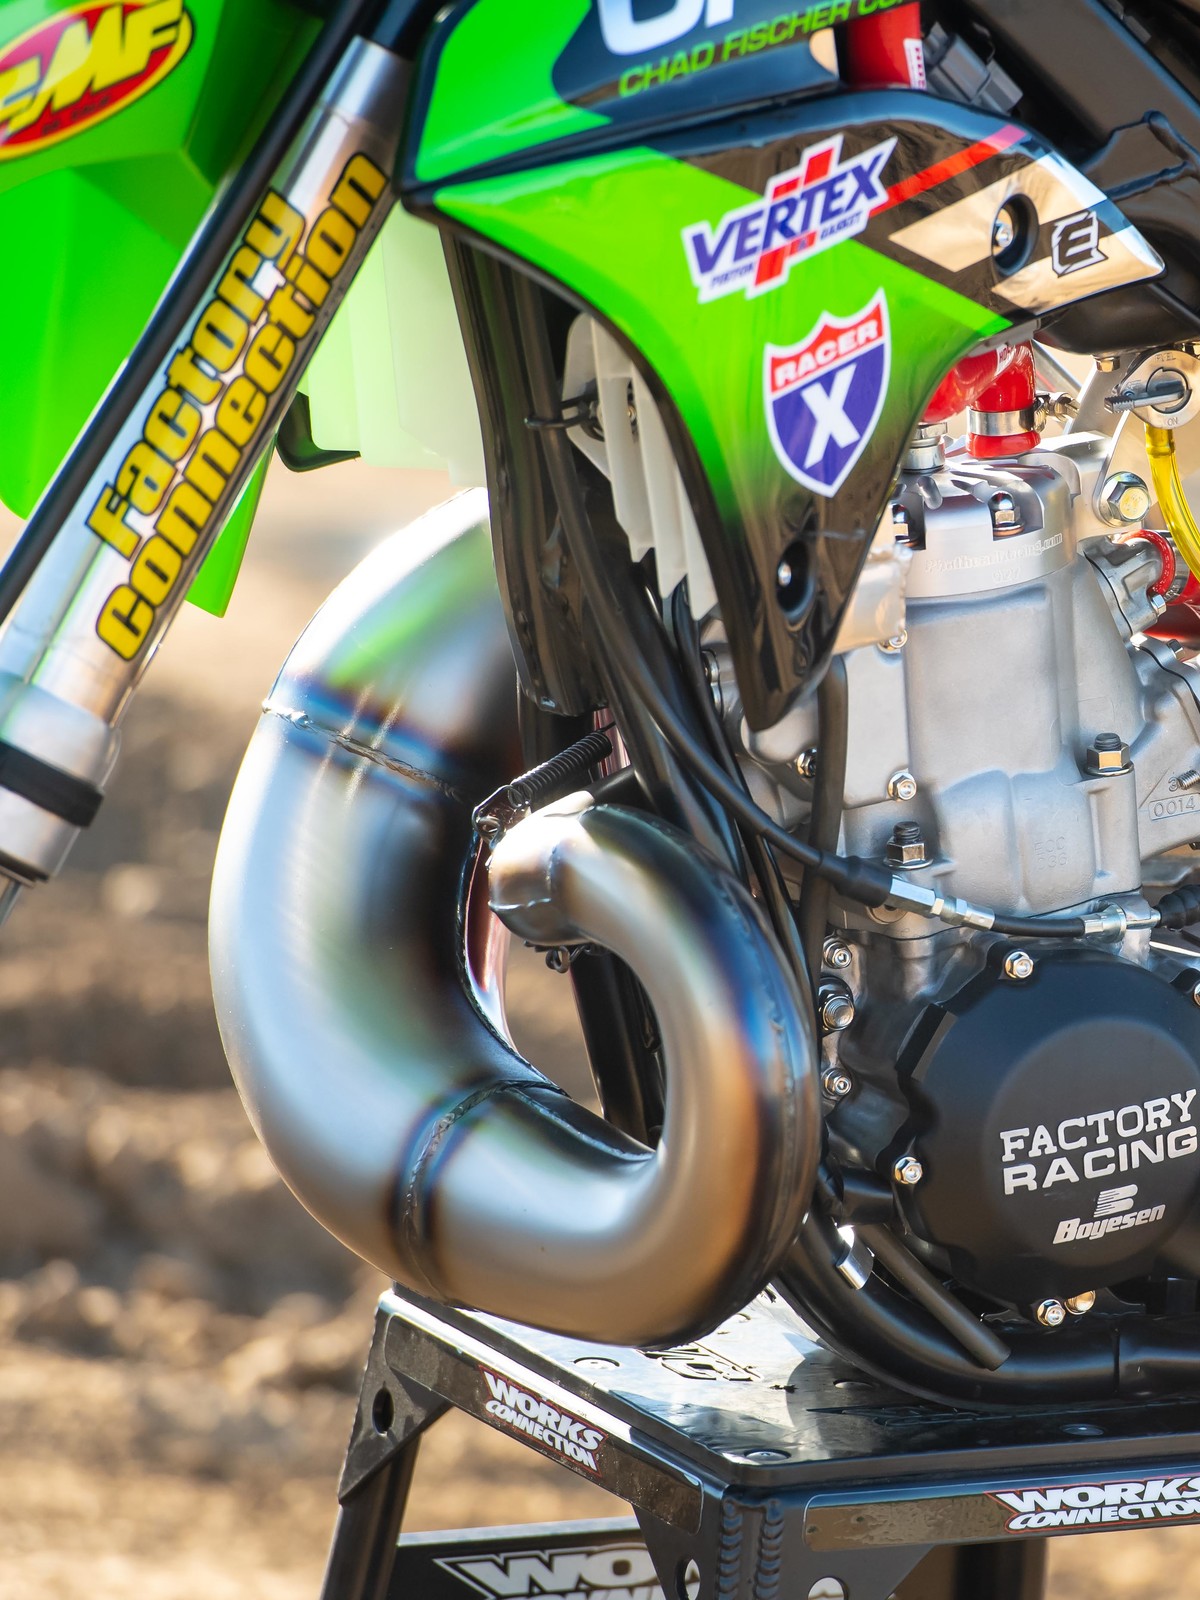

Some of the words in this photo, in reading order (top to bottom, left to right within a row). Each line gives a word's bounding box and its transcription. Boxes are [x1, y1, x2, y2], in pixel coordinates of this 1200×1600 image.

[618, 42, 714, 97] CHAD
[722, 0, 850, 63] FISCHER
[692, 153, 884, 274] VERTEX
[86, 188, 306, 561] Factory
[774, 319, 879, 389] RACER
[801, 362, 861, 470] X
[1153, 796, 1196, 818] 0014
[1000, 1088, 1197, 1162] FACTORY
[1003, 1126, 1198, 1195] RACING
[1052, 1204, 1166, 1245] Boyesen
[481, 1370, 604, 1451] WORKS
[485, 1399, 598, 1471] CONNECTION
